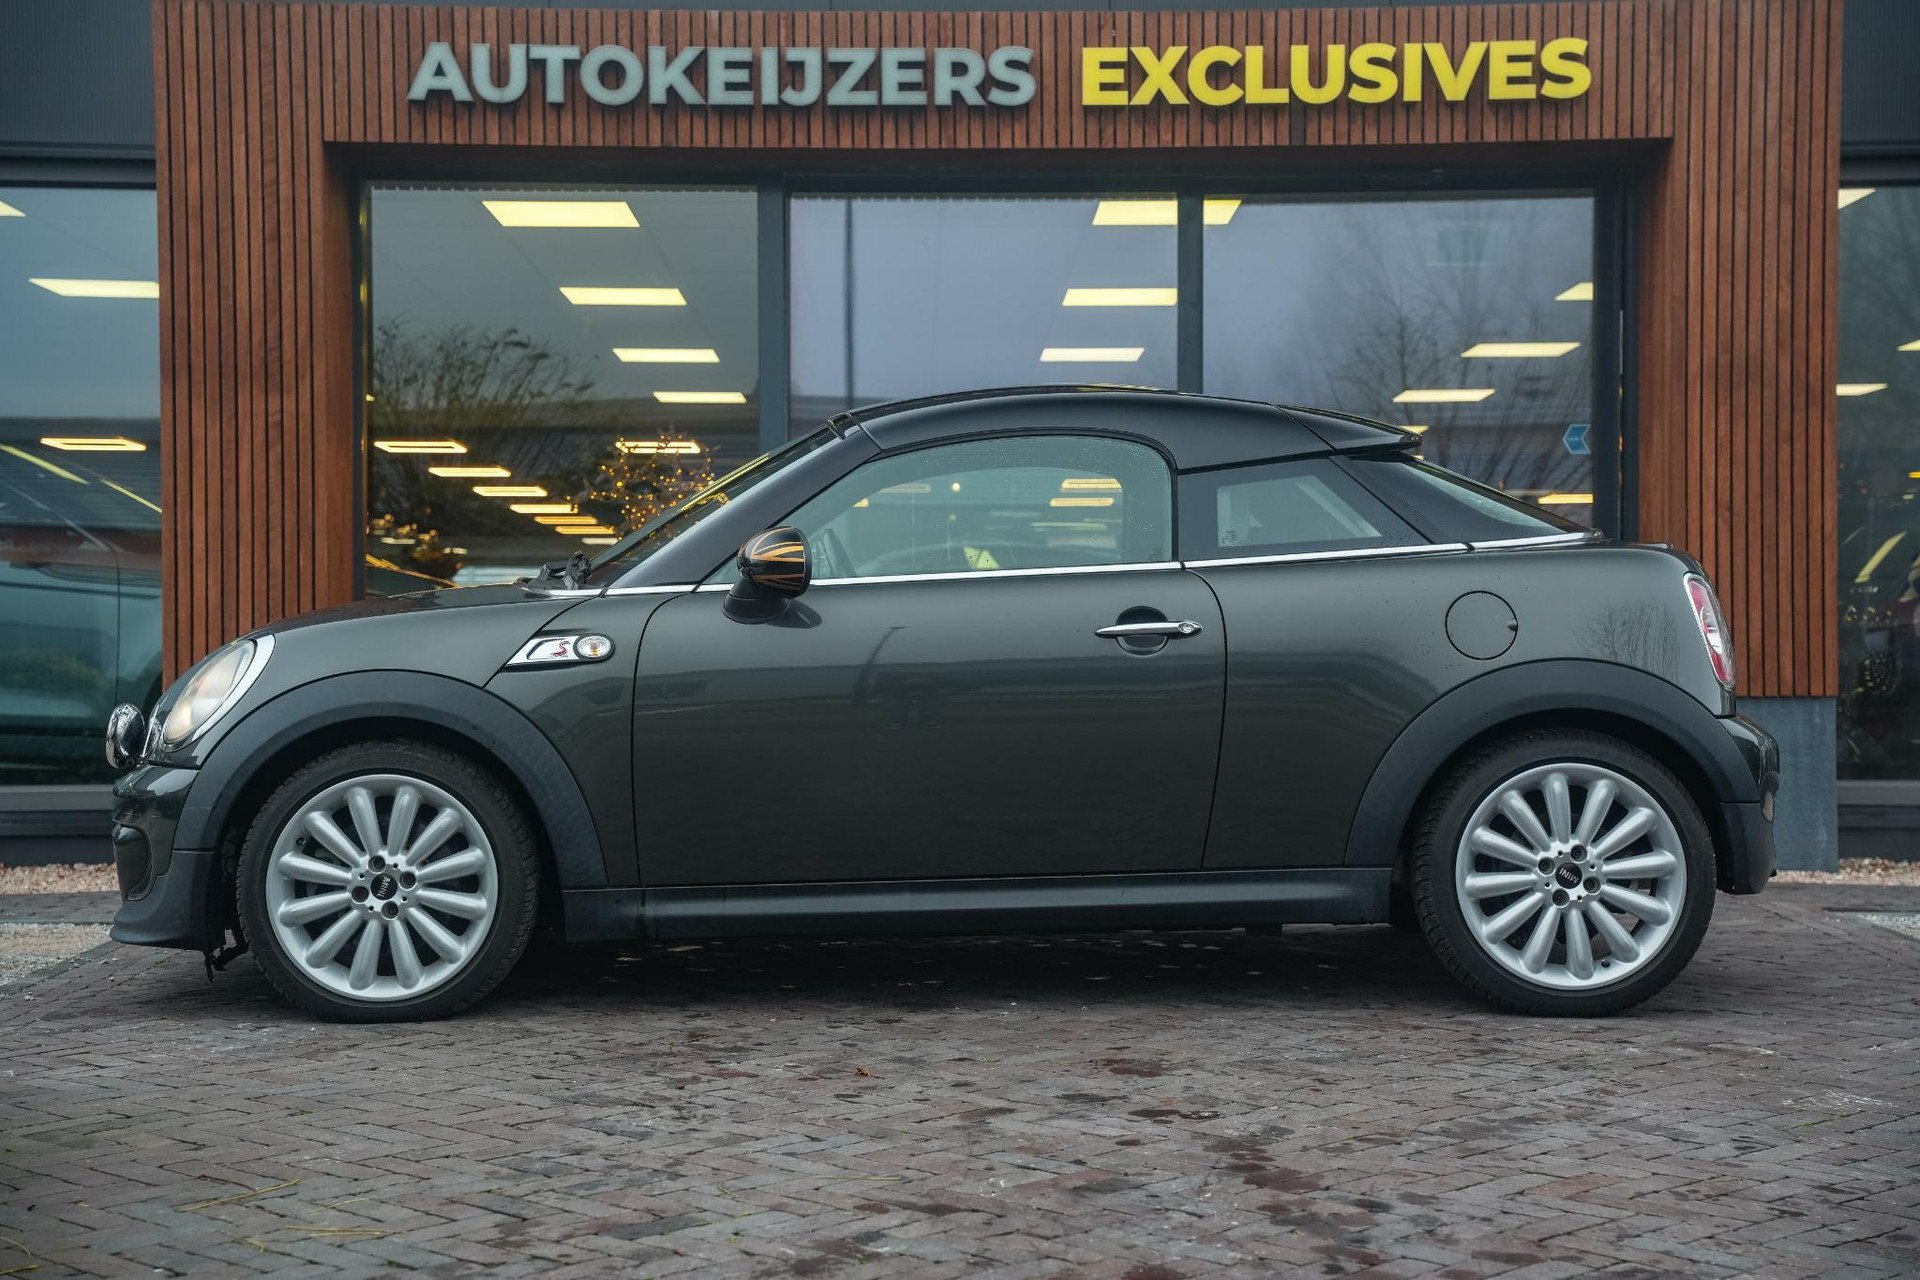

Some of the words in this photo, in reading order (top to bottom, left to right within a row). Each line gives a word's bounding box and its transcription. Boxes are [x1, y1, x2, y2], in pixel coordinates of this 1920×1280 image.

[406, 42, 1037, 106] AUTOKEIJZERS
[1081, 37, 1592, 106] EXCLUSIVES
[1558, 867, 1579, 884] MINI
